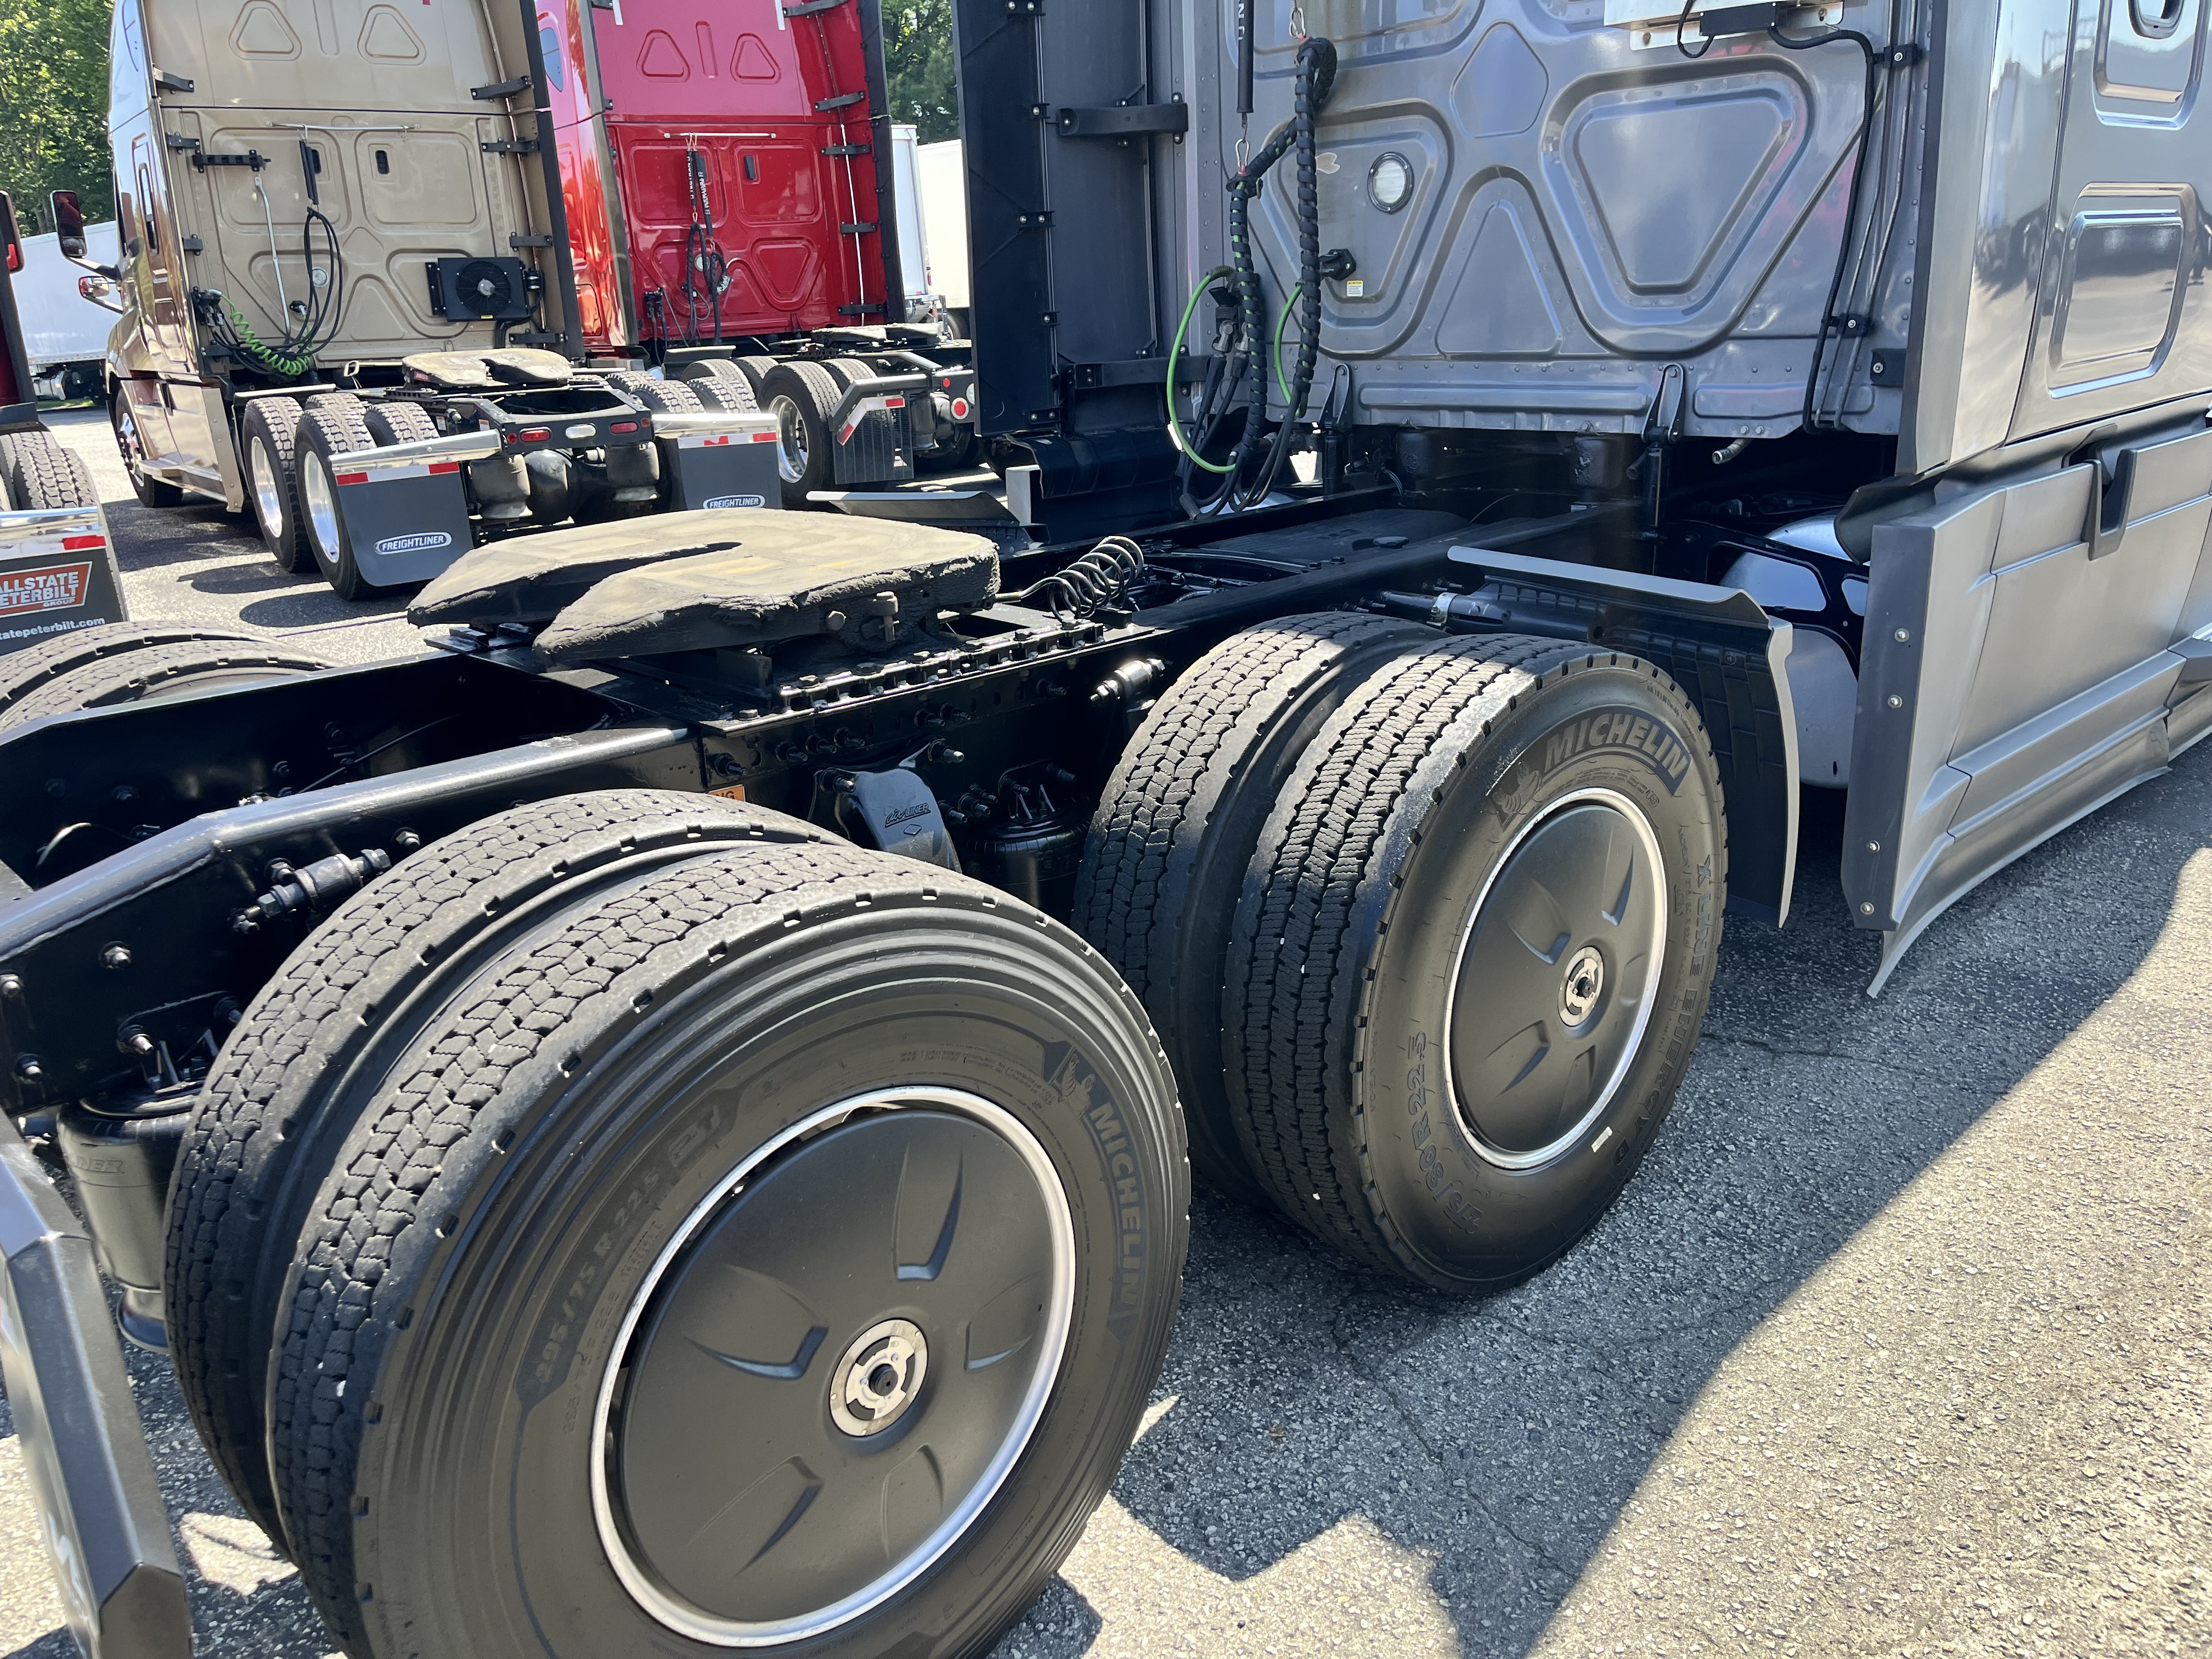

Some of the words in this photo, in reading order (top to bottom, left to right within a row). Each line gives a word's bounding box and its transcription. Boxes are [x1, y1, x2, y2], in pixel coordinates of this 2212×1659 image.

[709, 498, 759, 509] FREIGHTLINER
[382, 535, 444, 551] FREIGHTLINER
[0, 571, 78, 593] LLSTATE
[0, 584, 78, 606] ETERBILT
[43, 598, 75, 607] GROUP
[0, 617, 105, 640] tatepeterbilt.com
[1544, 713, 1689, 779] MICHELIN
[1697, 854, 1711, 888] X
[1689, 893, 1711, 976] LINE
[1635, 988, 1699, 1137] ENERGY
[1088, 1101, 1142, 1306] MICHELIN
